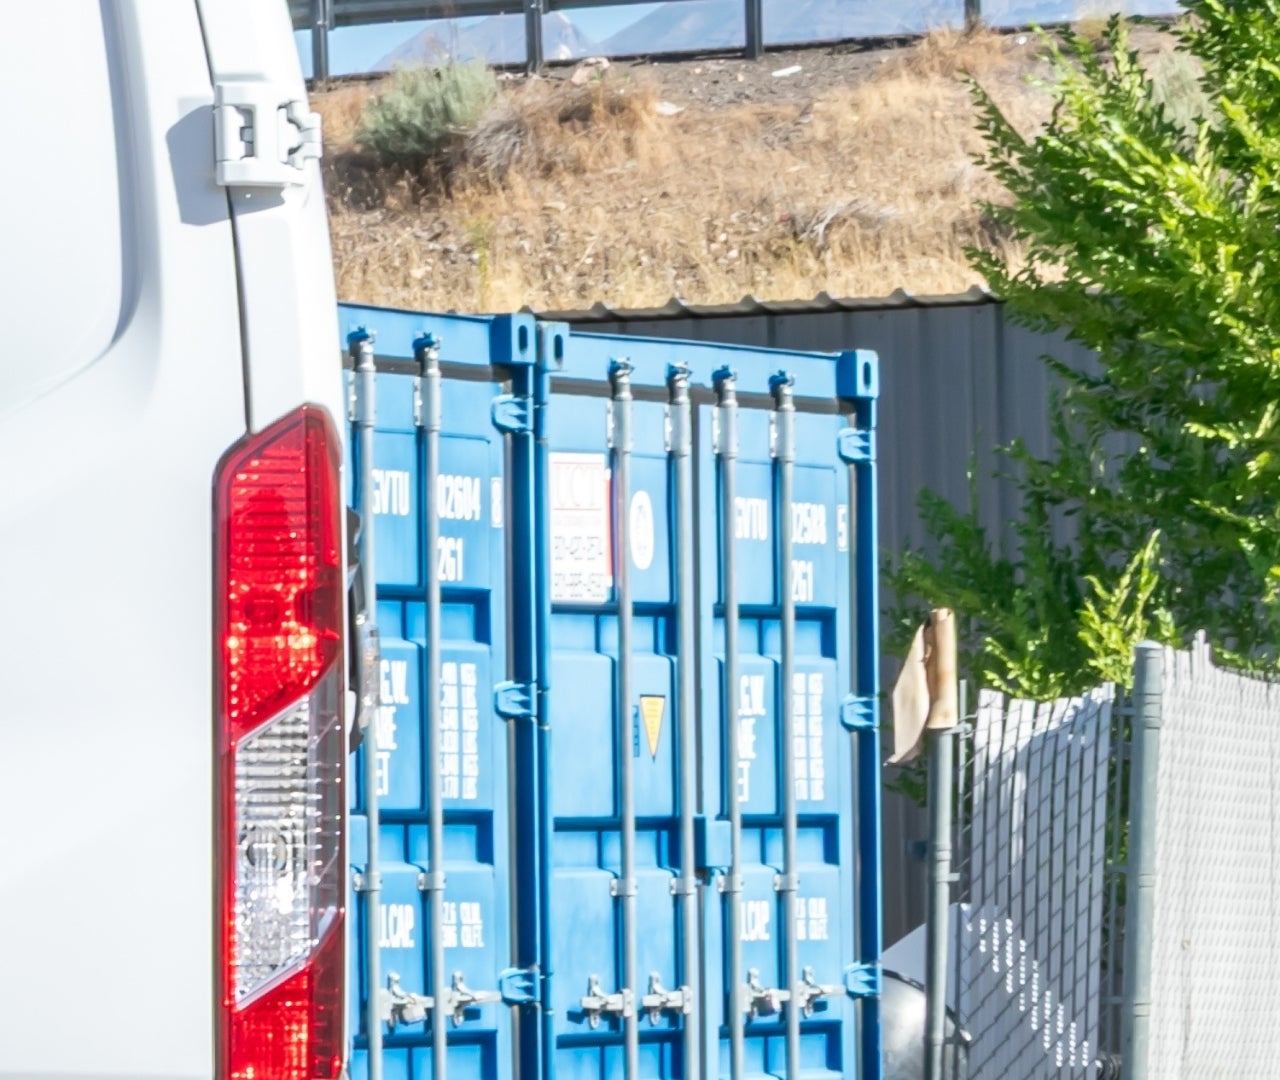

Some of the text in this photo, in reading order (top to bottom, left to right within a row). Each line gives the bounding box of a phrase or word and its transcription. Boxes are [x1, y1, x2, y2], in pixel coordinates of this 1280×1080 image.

[436, 473, 483, 521] 02604
[436, 536, 465, 582] 2G1
[790, 559, 814, 603] 2G1
